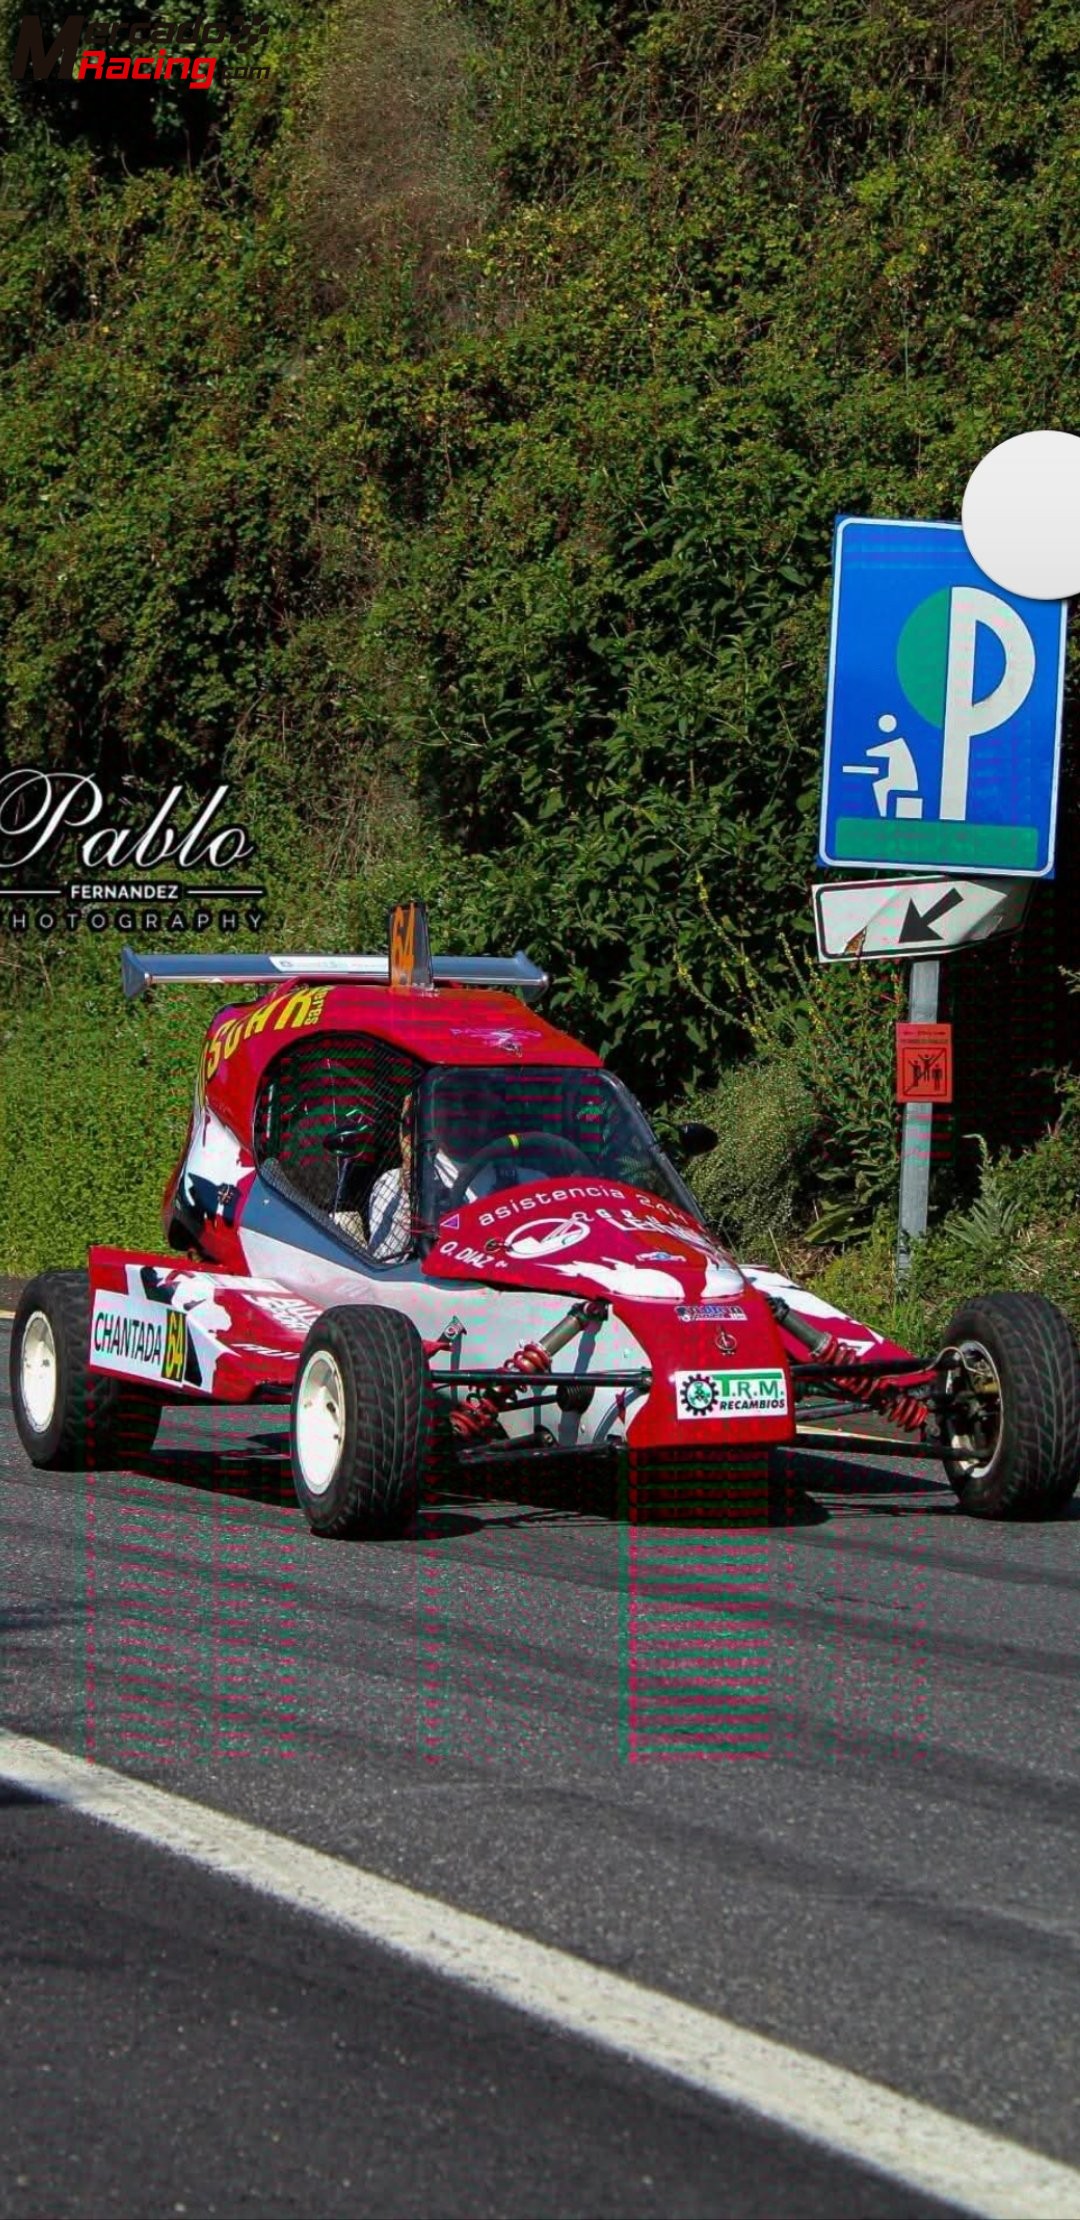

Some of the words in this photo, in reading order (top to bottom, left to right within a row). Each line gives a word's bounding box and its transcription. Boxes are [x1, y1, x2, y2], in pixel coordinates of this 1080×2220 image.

[940, 586, 1035, 820] P
[391, 903, 415, 974] 64
[479, 1185, 625, 1227] asistencia
[455, 1247, 495, 1268] DIAZ
[95, 1311, 161, 1366] CHANTADA
[165, 1312, 185, 1379] 64
[712, 1372, 784, 1399] T.R.M.
[719, 1399, 785, 1410] RECAMBIOS
